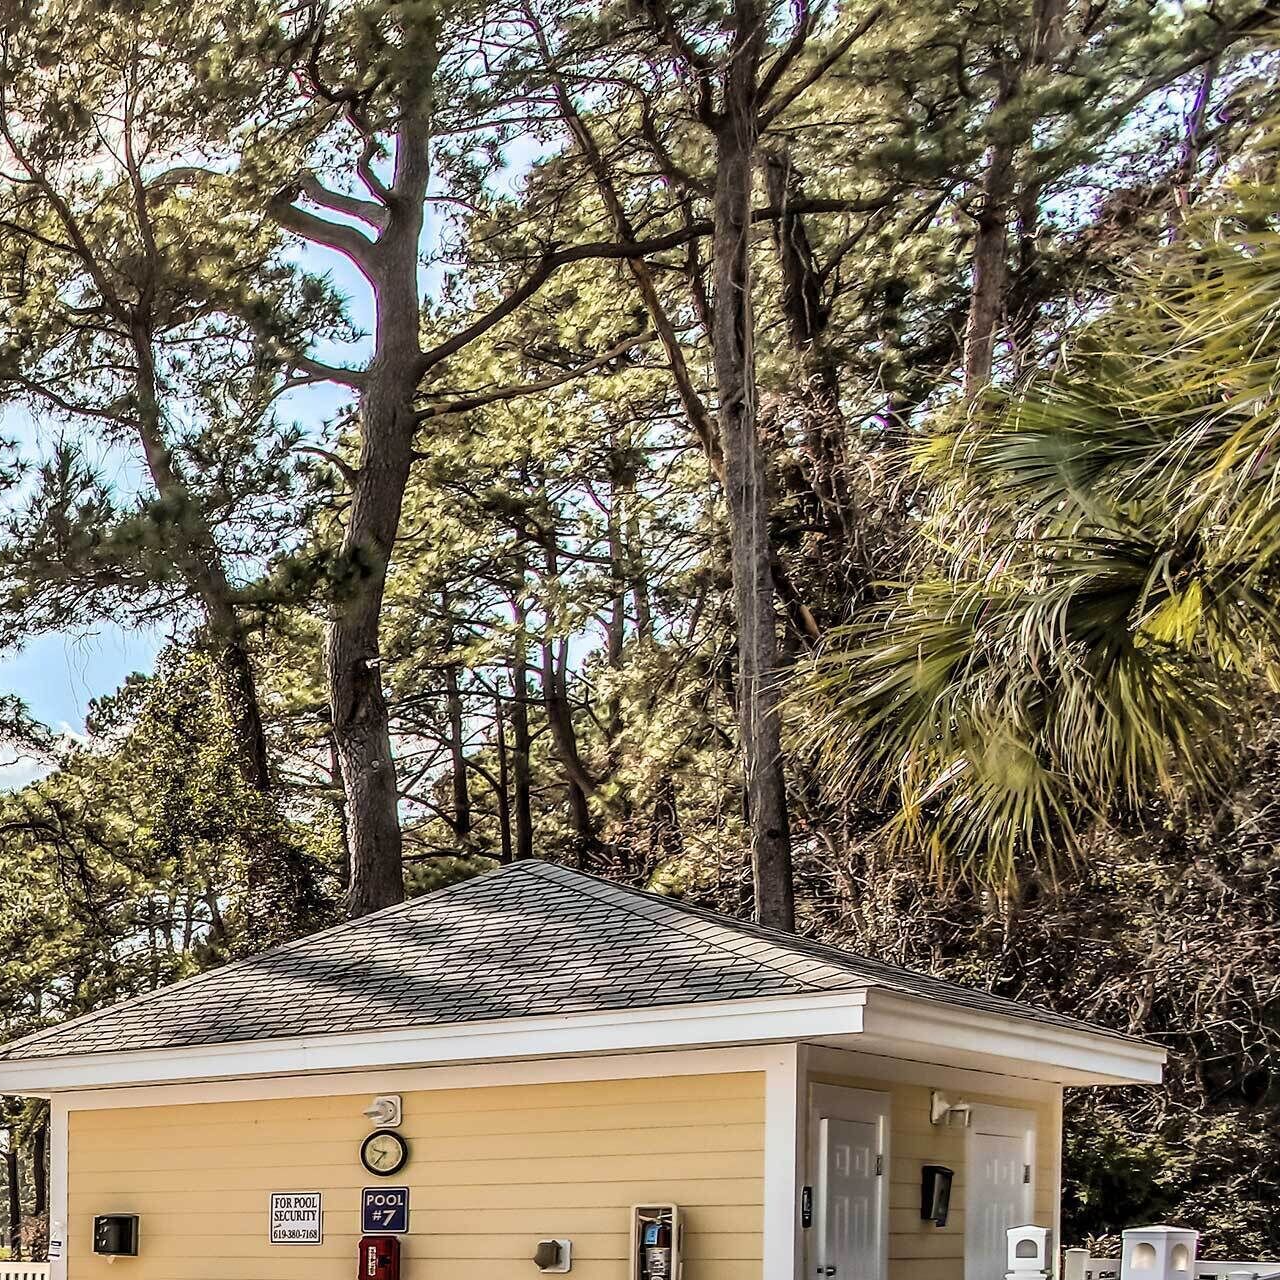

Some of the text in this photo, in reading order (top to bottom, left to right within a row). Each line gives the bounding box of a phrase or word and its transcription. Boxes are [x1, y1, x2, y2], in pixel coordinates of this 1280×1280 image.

[274, 1197, 317, 1208] FOR POOL
[367, 1194, 404, 1206] POOL
[273, 1210, 317, 1221] SECURITY
[371, 1209, 396, 1226] #7
